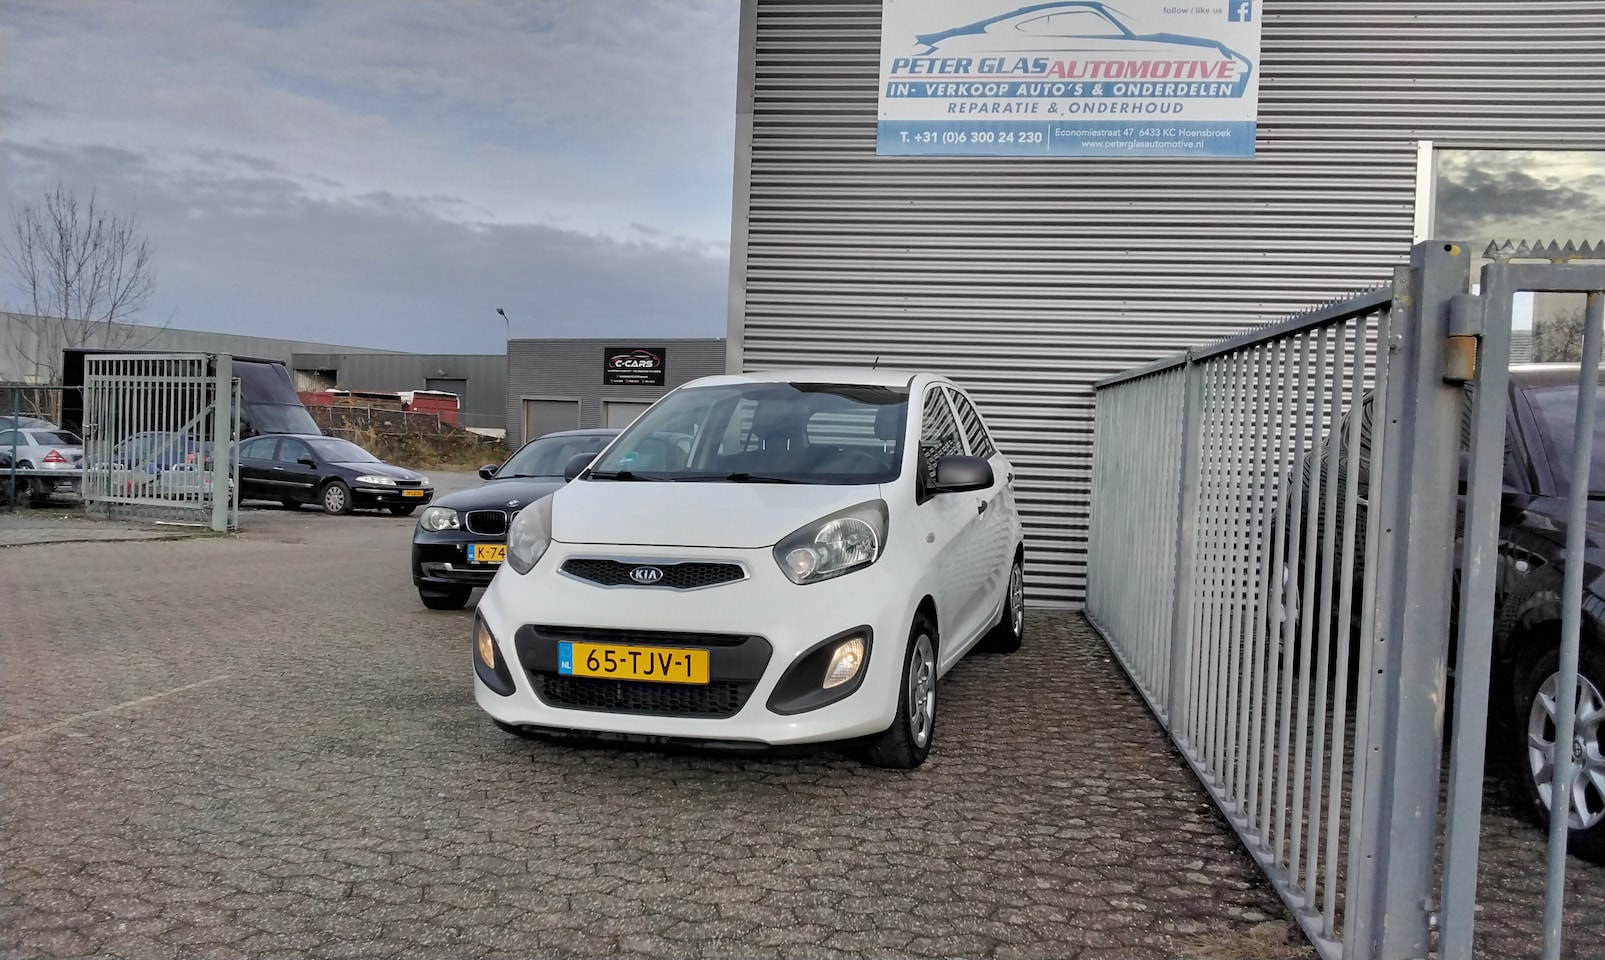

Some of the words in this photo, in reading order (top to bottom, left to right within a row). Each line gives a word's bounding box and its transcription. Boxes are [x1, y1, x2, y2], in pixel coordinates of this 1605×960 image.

[890, 57, 973, 74] PETER
[889, 83, 916, 96] IN-
[925, 83, 1010, 96] VERKOOP
[1015, 83, 1084, 96] AUTO'S
[1091, 83, 1104, 96] &
[1113, 83, 1233, 96] ONDERDELEN
[947, 102, 1040, 114] REPARATIE
[1047, 102, 1058, 114] &
[1068, 102, 1184, 114] ONDERHOUD
[899, 131, 910, 143] T.
[914, 132, 938, 143] +31
[942, 131, 967, 145] (0)6
[970, 132, 995, 143] 300
[998, 132, 1015, 143] 24
[1018, 132, 1043, 143] 230
[1055, 128, 1121, 137] Economiestraat
[1122, 128, 1134, 137] 47
[1138, 128, 1161, 137] 6433
[1162, 128, 1176, 137] KC
[1178, 128, 1231, 138] Hoensbroek
[1081, 139, 1204, 150] www.peterglasautomotive.nl
[635, 569, 657, 580] KIA
[561, 661, 572, 669] NL
[586, 649, 692, 677] 65-TJV-1
